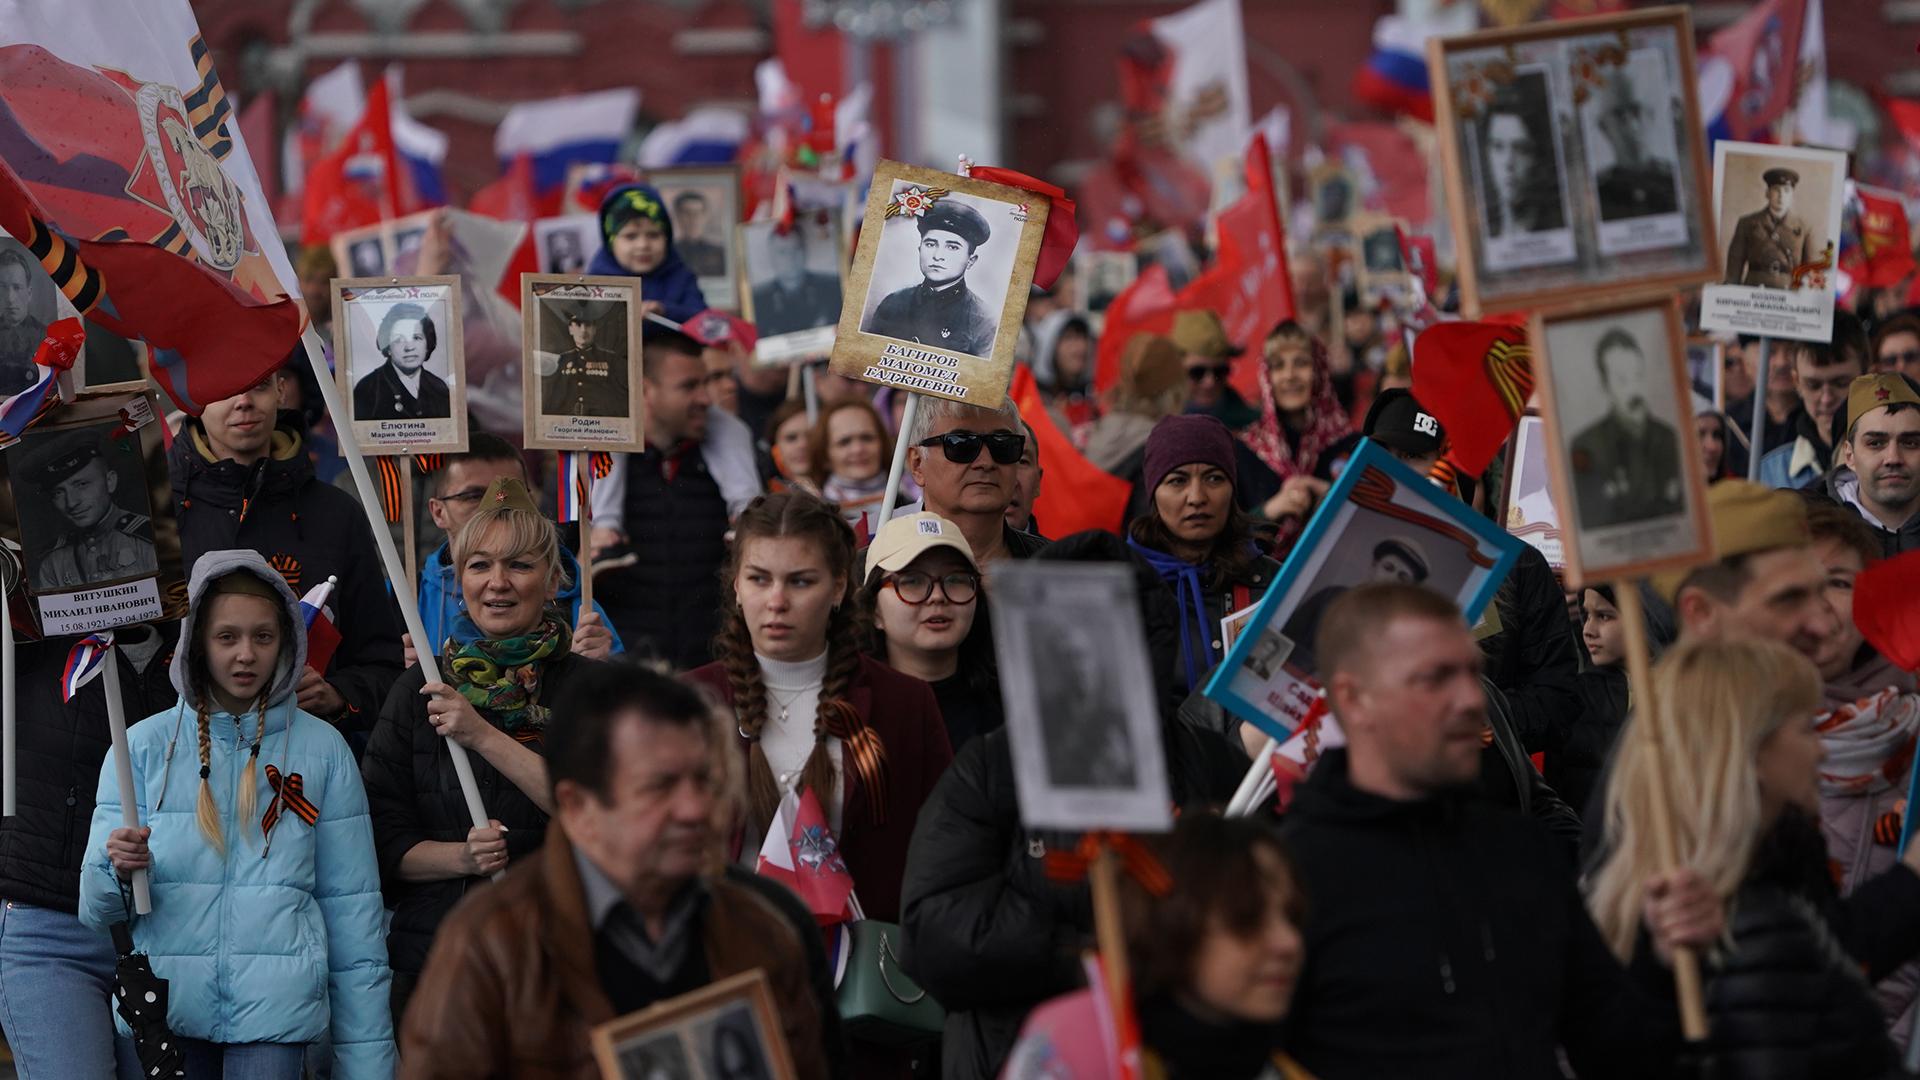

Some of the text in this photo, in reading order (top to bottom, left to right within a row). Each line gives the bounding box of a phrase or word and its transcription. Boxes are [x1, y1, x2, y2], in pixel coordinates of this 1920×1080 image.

[886, 344, 959, 368] БАГИРОВ
[880, 357, 959, 382] МАГОМЕД
[865, 367, 968, 396] ГАДЖИЕВИЧ
[380, 421, 426, 430] Елютина
[553, 425, 618, 434] Георгий Иванович
[571, 417, 601, 427] Родин
[370, 430, 436, 439] Мария Фроловна
[73, 585, 138, 602] ВИТУШКИН
[43, 596, 156, 619] МИХАИЛ ИВАНОВИЧ
[113, 609, 159, 626] 23.04.1975
